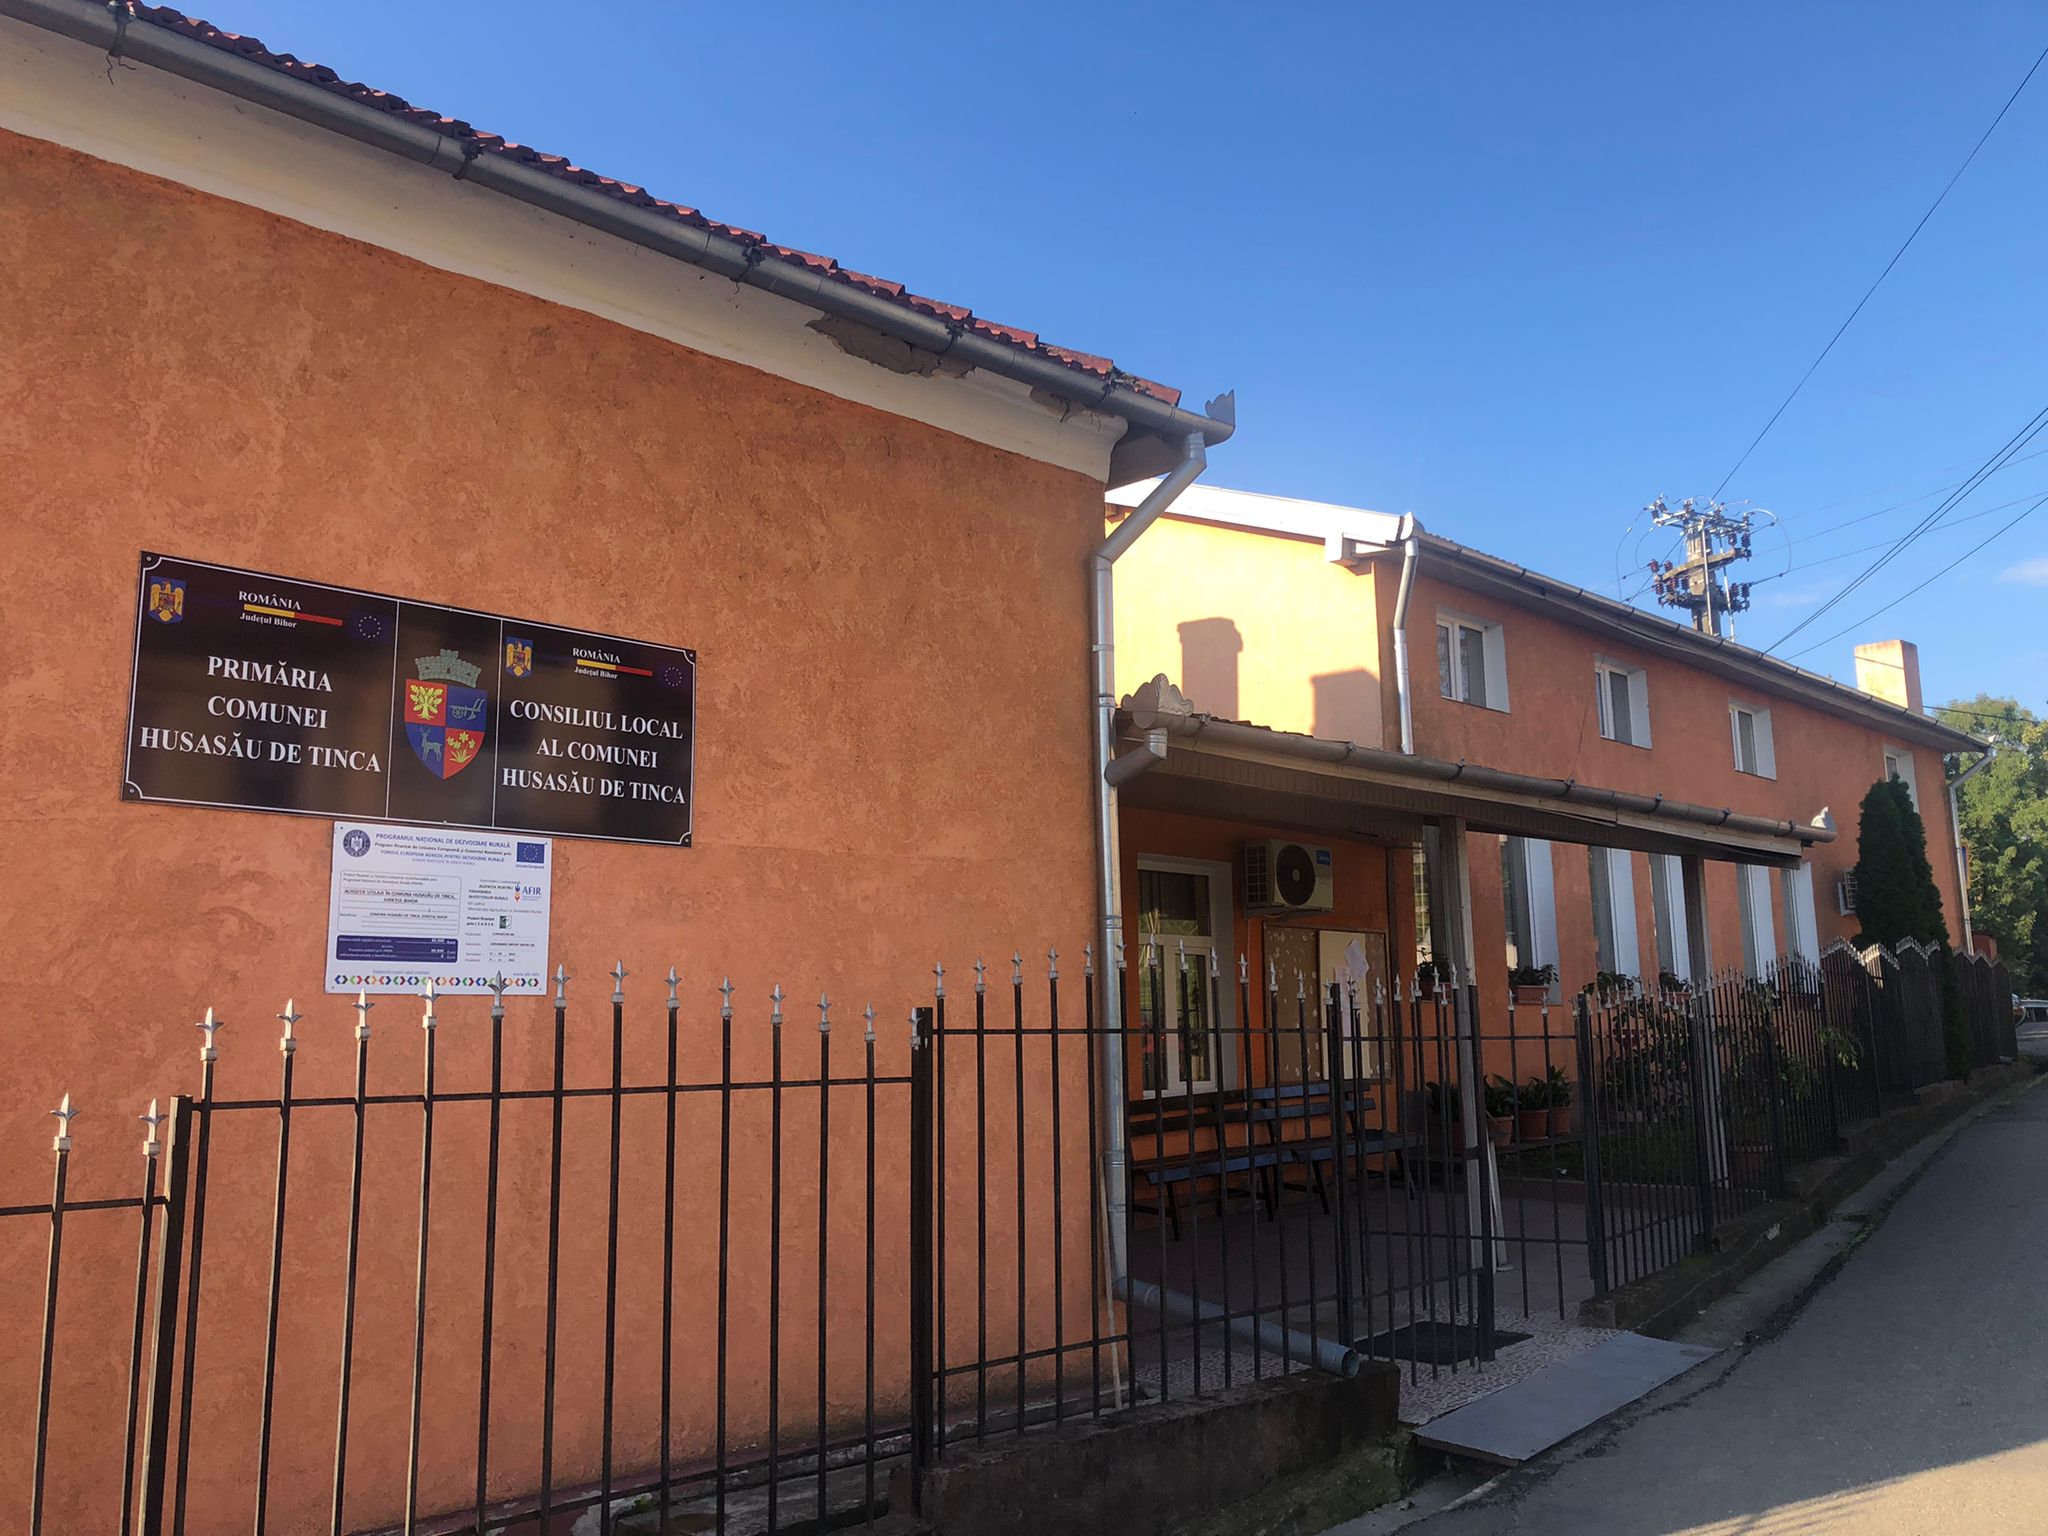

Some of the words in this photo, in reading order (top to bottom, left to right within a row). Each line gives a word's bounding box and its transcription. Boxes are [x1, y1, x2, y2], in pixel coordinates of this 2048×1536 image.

[238, 590, 302, 611] ROMÂNIA
[274, 616, 297, 628] Bihor
[572, 647, 621, 664] ROMÂNIA
[206, 655, 333, 693] PRIMĂRIA
[600, 670, 618, 680] Bihor
[207, 694, 328, 729] COMUNEI
[510, 699, 617, 731] CONSILIUL
[620, 716, 683, 739] LOCAL
[139, 726, 263, 760] HUSASĂU
[269, 741, 301, 765] DE
[308, 745, 381, 773] TINCA
[536, 738, 564, 758] AL
[567, 741, 658, 769] COMUNEI
[502, 767, 595, 796] HUSASĂU
[599, 778, 625, 798] DE
[629, 782, 686, 804] TINCA
[375, 832, 414, 842] PROGRAMUL
[522, 886, 542, 896] AFIR
